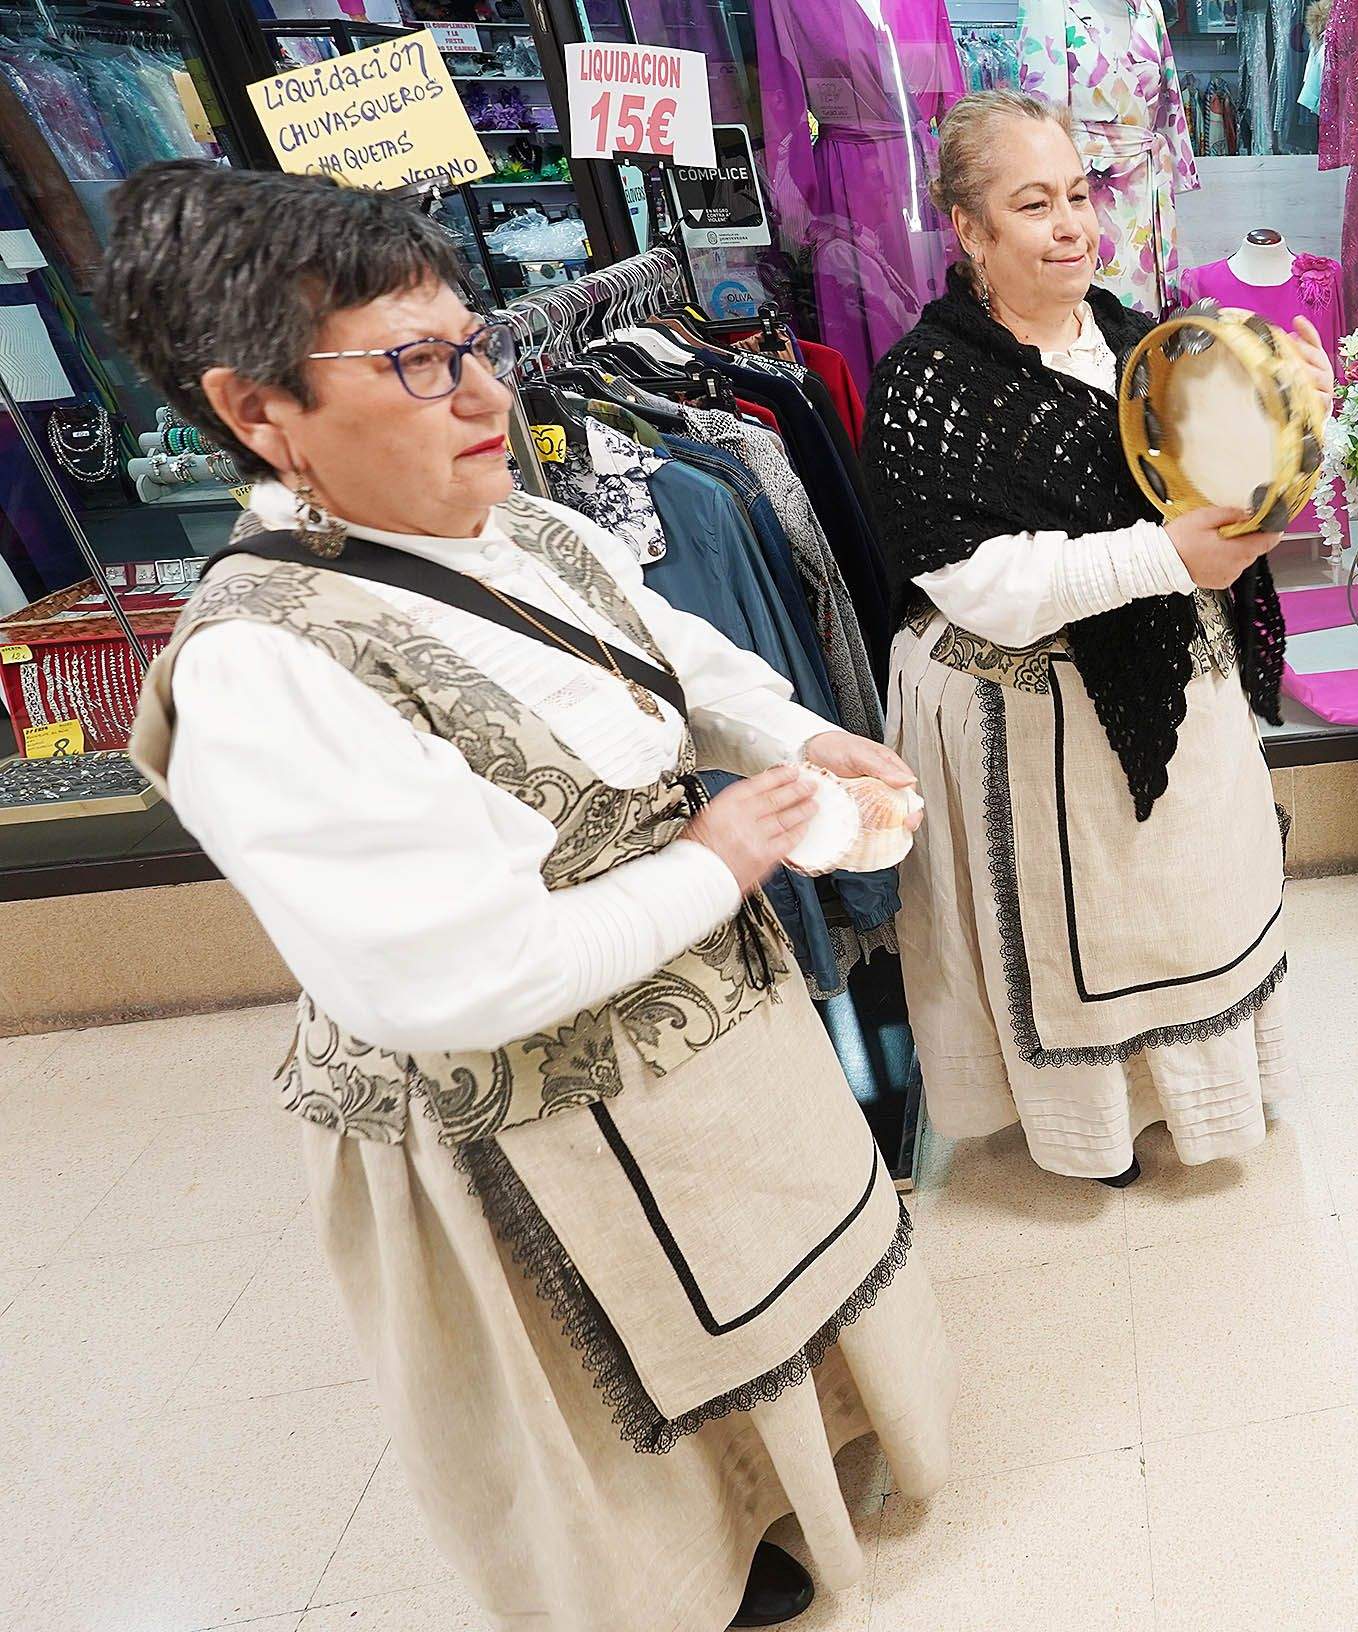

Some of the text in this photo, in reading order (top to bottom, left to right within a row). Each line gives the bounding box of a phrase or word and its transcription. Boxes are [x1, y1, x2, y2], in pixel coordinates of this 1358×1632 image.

[580, 48, 681, 89] LIQUIDACION
[279, 79, 444, 152] CHUVASQUEROS
[590, 91, 677, 155] 15€
[727, 293, 754, 303] OLIVA
